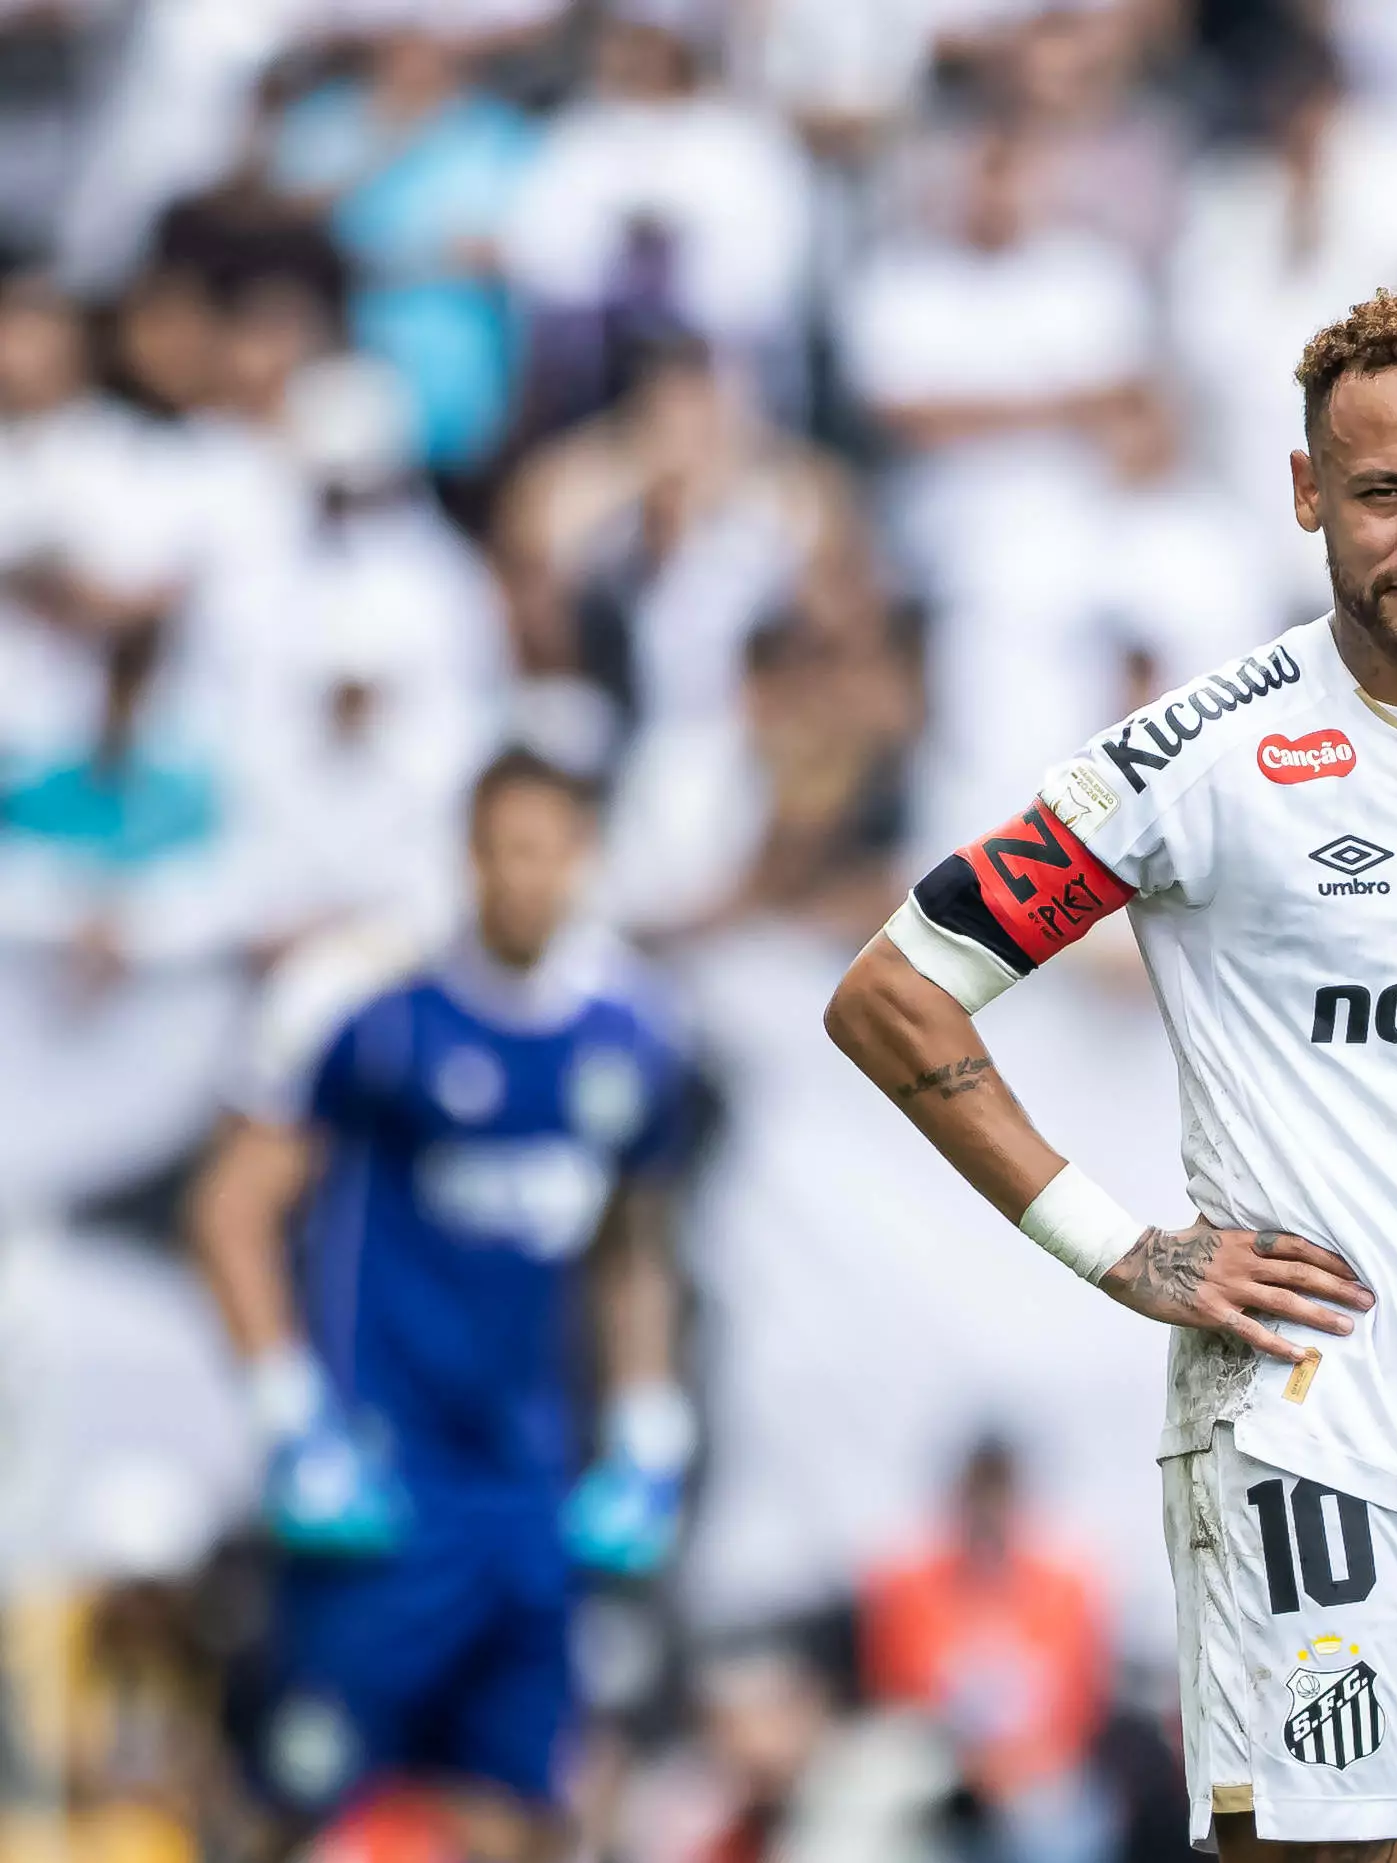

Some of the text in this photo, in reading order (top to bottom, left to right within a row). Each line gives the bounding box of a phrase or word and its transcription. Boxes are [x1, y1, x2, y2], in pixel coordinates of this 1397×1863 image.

[1261, 740, 1352, 773] Canção
[981, 805, 1073, 905] N
[1318, 878, 1391, 896] umbro
[1246, 1477, 1377, 1614] 10
